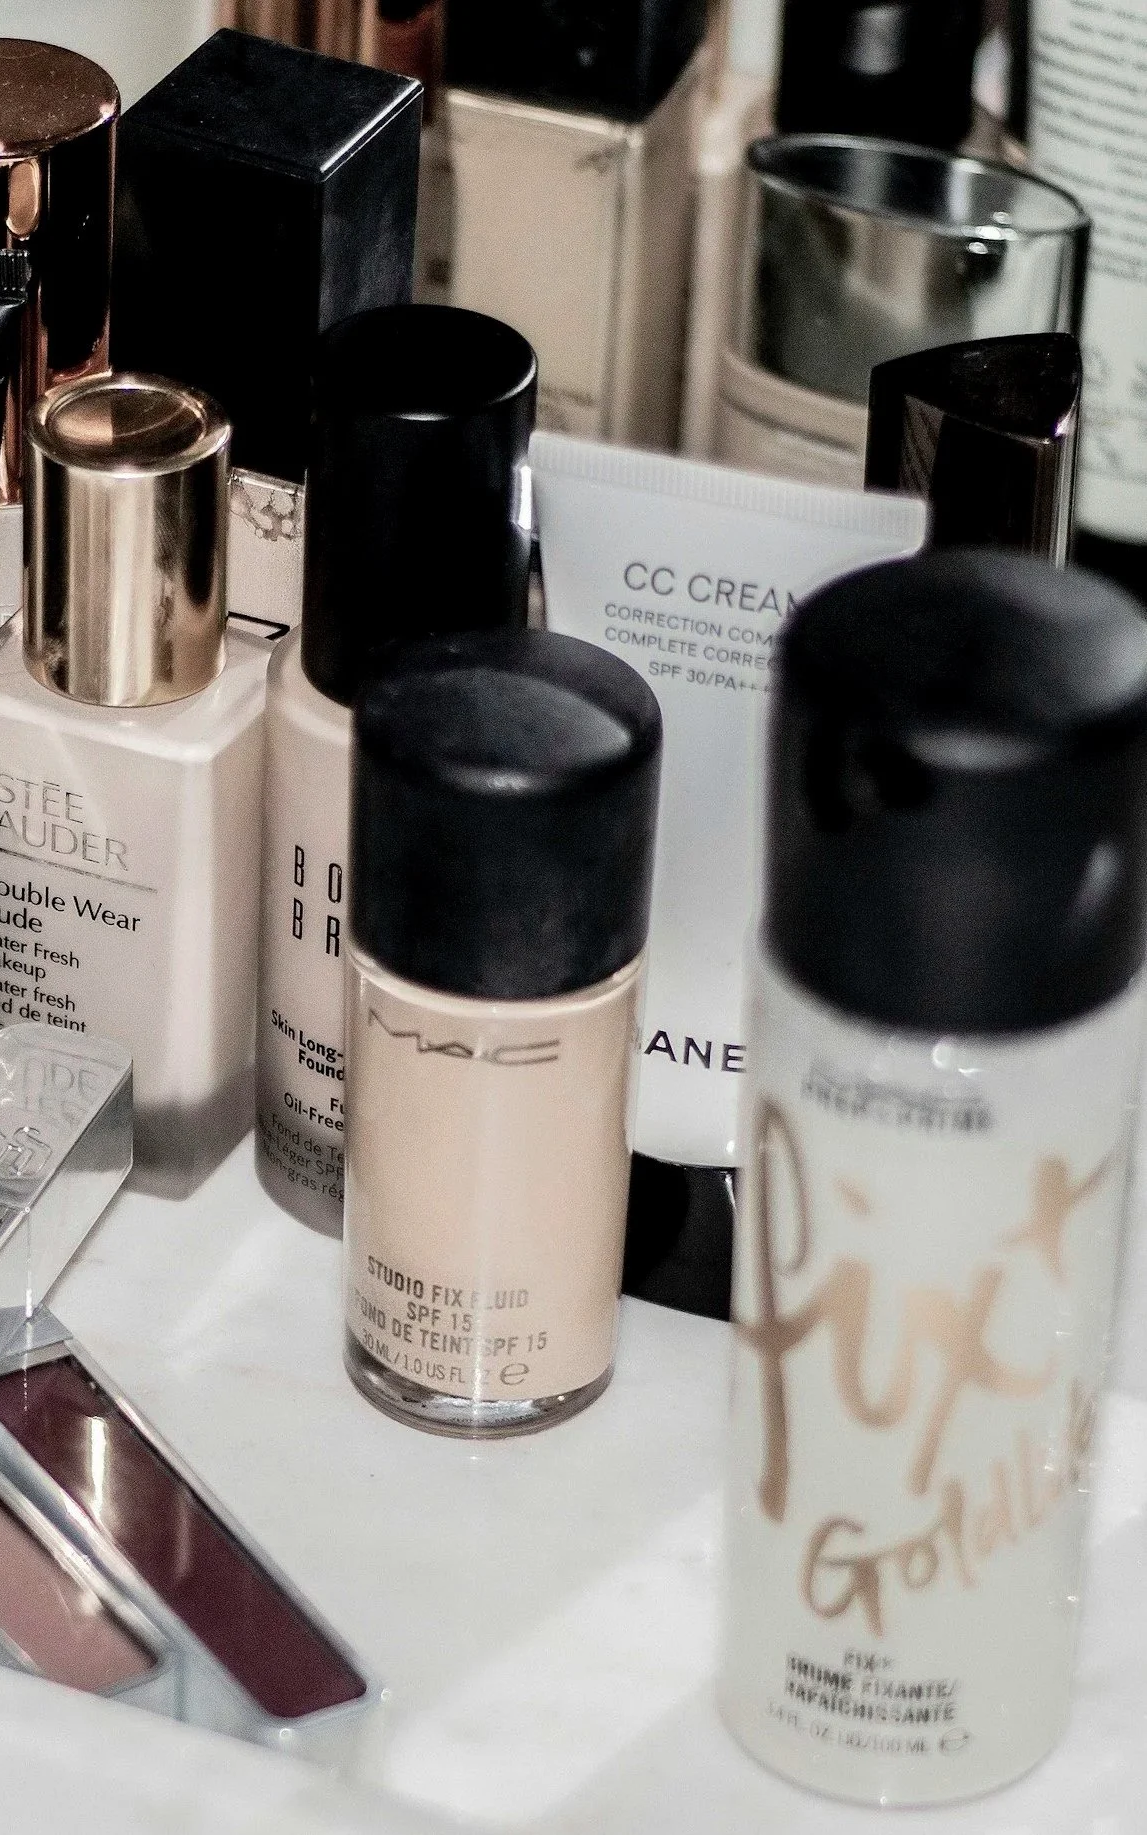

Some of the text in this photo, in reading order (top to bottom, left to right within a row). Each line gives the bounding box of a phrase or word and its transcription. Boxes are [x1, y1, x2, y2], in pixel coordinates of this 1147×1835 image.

[623, 562, 675, 596] CC
[604, 603, 723, 638] CORRECTION
[604, 626, 698, 658] COMPLETE
[648, 660, 682, 680] SPF
[73, 895, 141, 932] Wear
[33, 942, 80, 969] Fresh
[32, 986, 76, 1012] fresh
[19, 1002, 41, 1021] de
[47, 1011, 87, 1033] teint
[270, 1008, 344, 1064] Skin Long-
[284, 1091, 345, 1132] Oil-Free
[303, 1136, 322, 1156] de
[367, 1254, 425, 1300] STUDIO
[432, 1284, 464, 1308] FIX
[406, 1301, 473, 1333] SPF 15
[391, 1317, 413, 1343] DE
[419, 1328, 474, 1355] TEINT
[527, 1330, 549, 1353] 15
[426, 1360, 446, 1380] US
